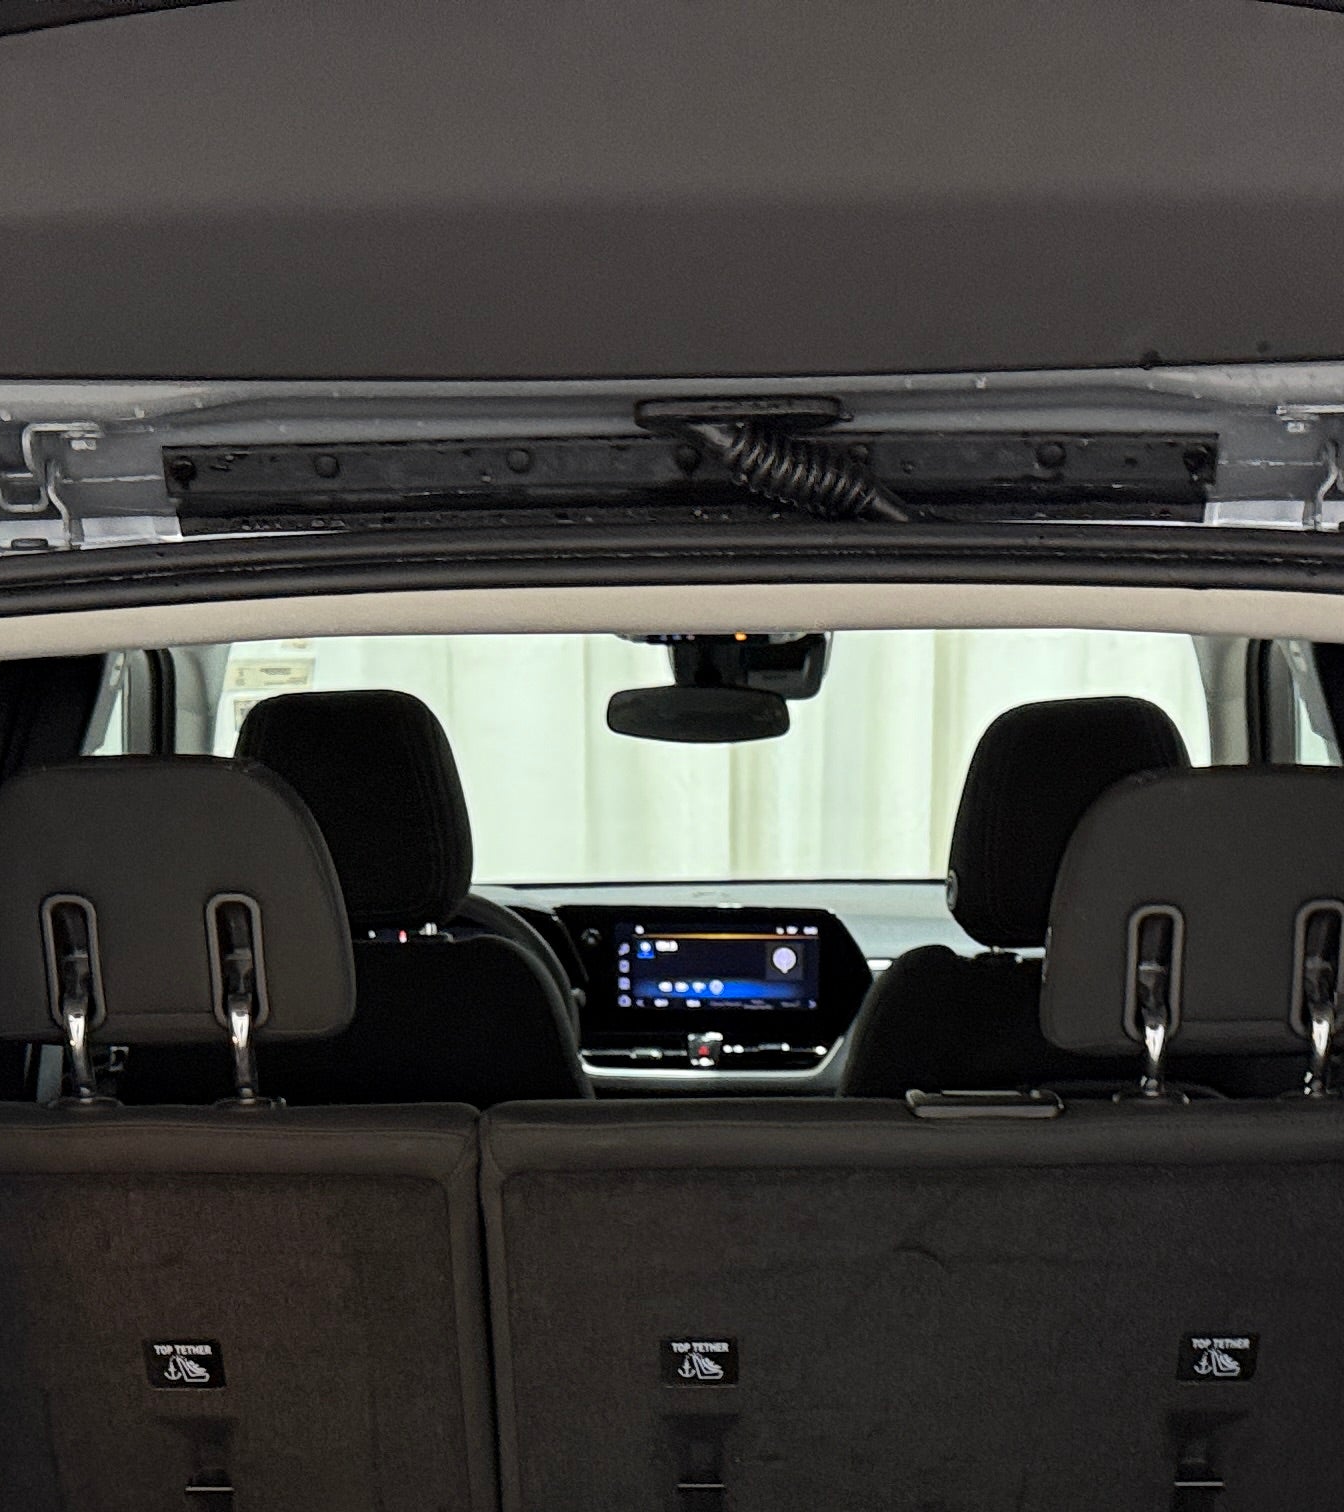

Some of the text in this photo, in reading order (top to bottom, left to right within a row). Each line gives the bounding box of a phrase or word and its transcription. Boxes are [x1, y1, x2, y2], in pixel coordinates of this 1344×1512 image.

[670, 1342, 691, 1353] TOP
[1190, 1337, 1212, 1349] TOP
[153, 1344, 213, 1356] TOP TETHER
